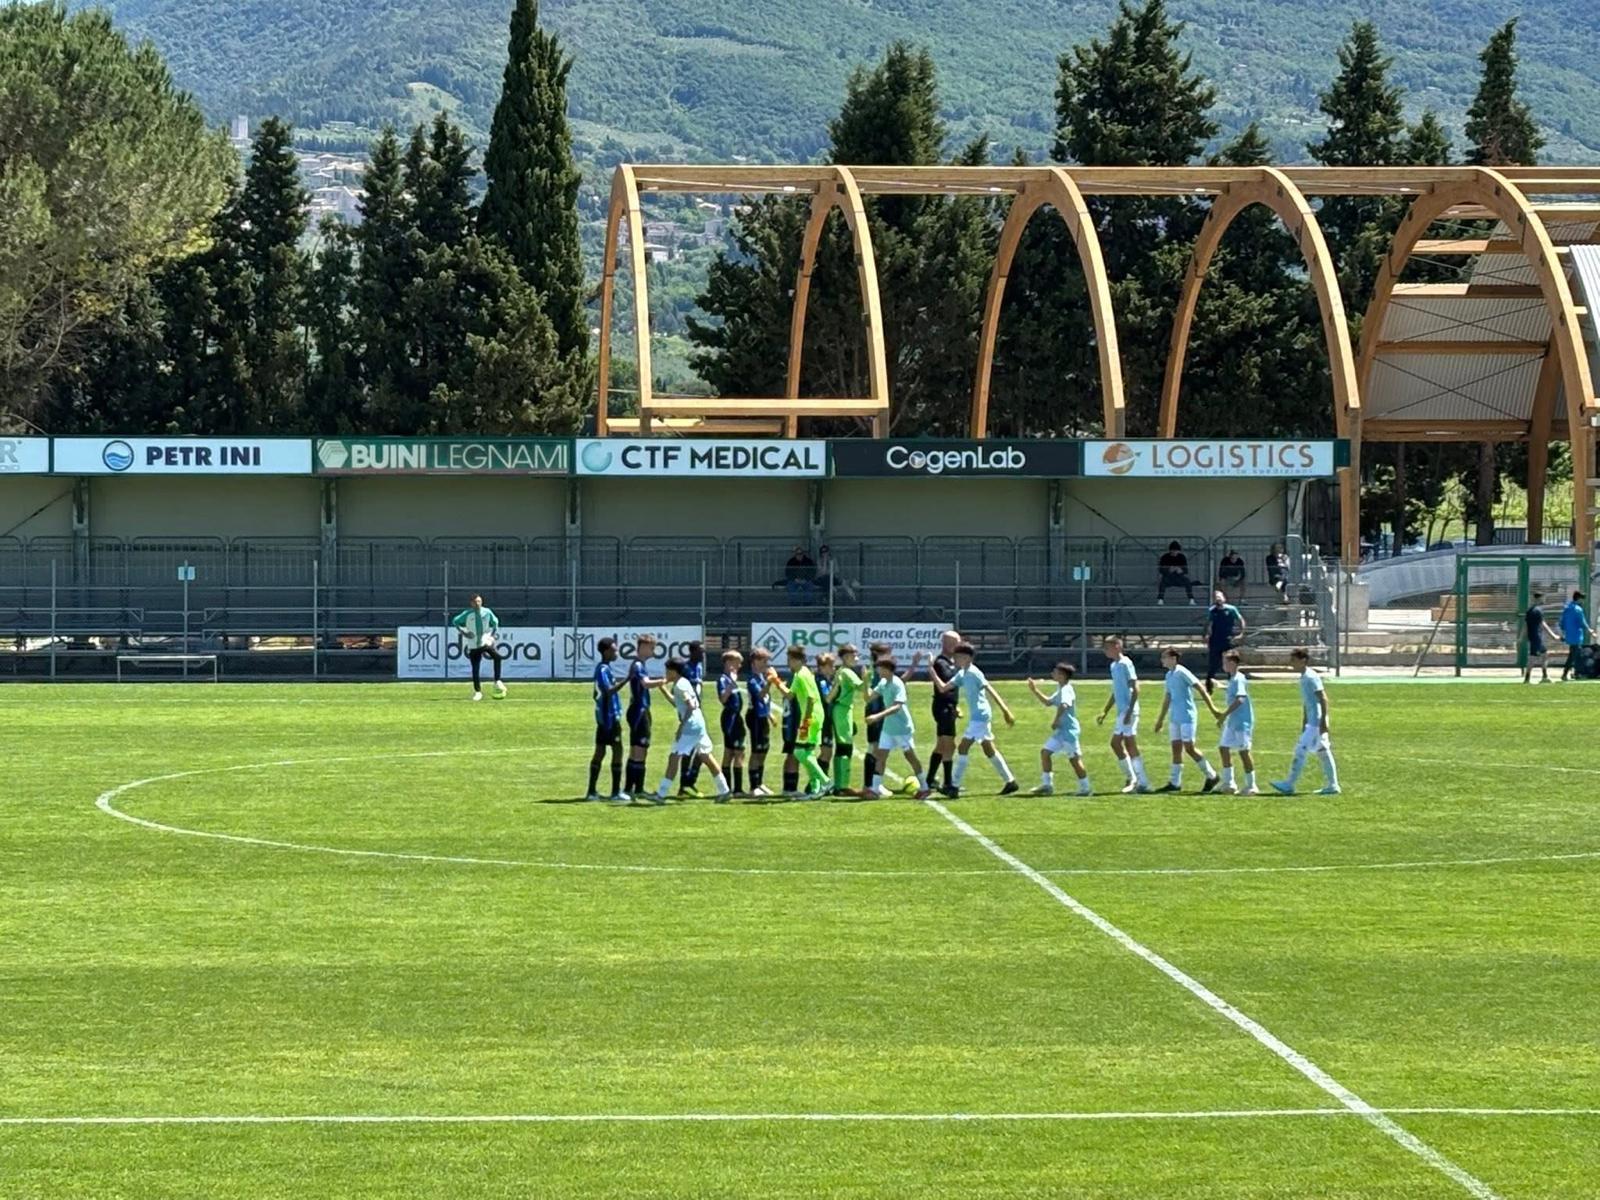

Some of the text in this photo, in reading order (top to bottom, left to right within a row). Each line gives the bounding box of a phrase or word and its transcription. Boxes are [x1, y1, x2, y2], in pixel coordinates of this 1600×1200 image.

[351, 444, 568, 469] BUINI LEGNAMI
[621, 445, 819, 470] CTF MEDICAL
[886, 446, 1026, 474] CogenLab
[1152, 444, 1315, 469] LOGISTICS
[791, 629, 849, 647] BCC
[861, 627, 945, 639] Banca Centr
